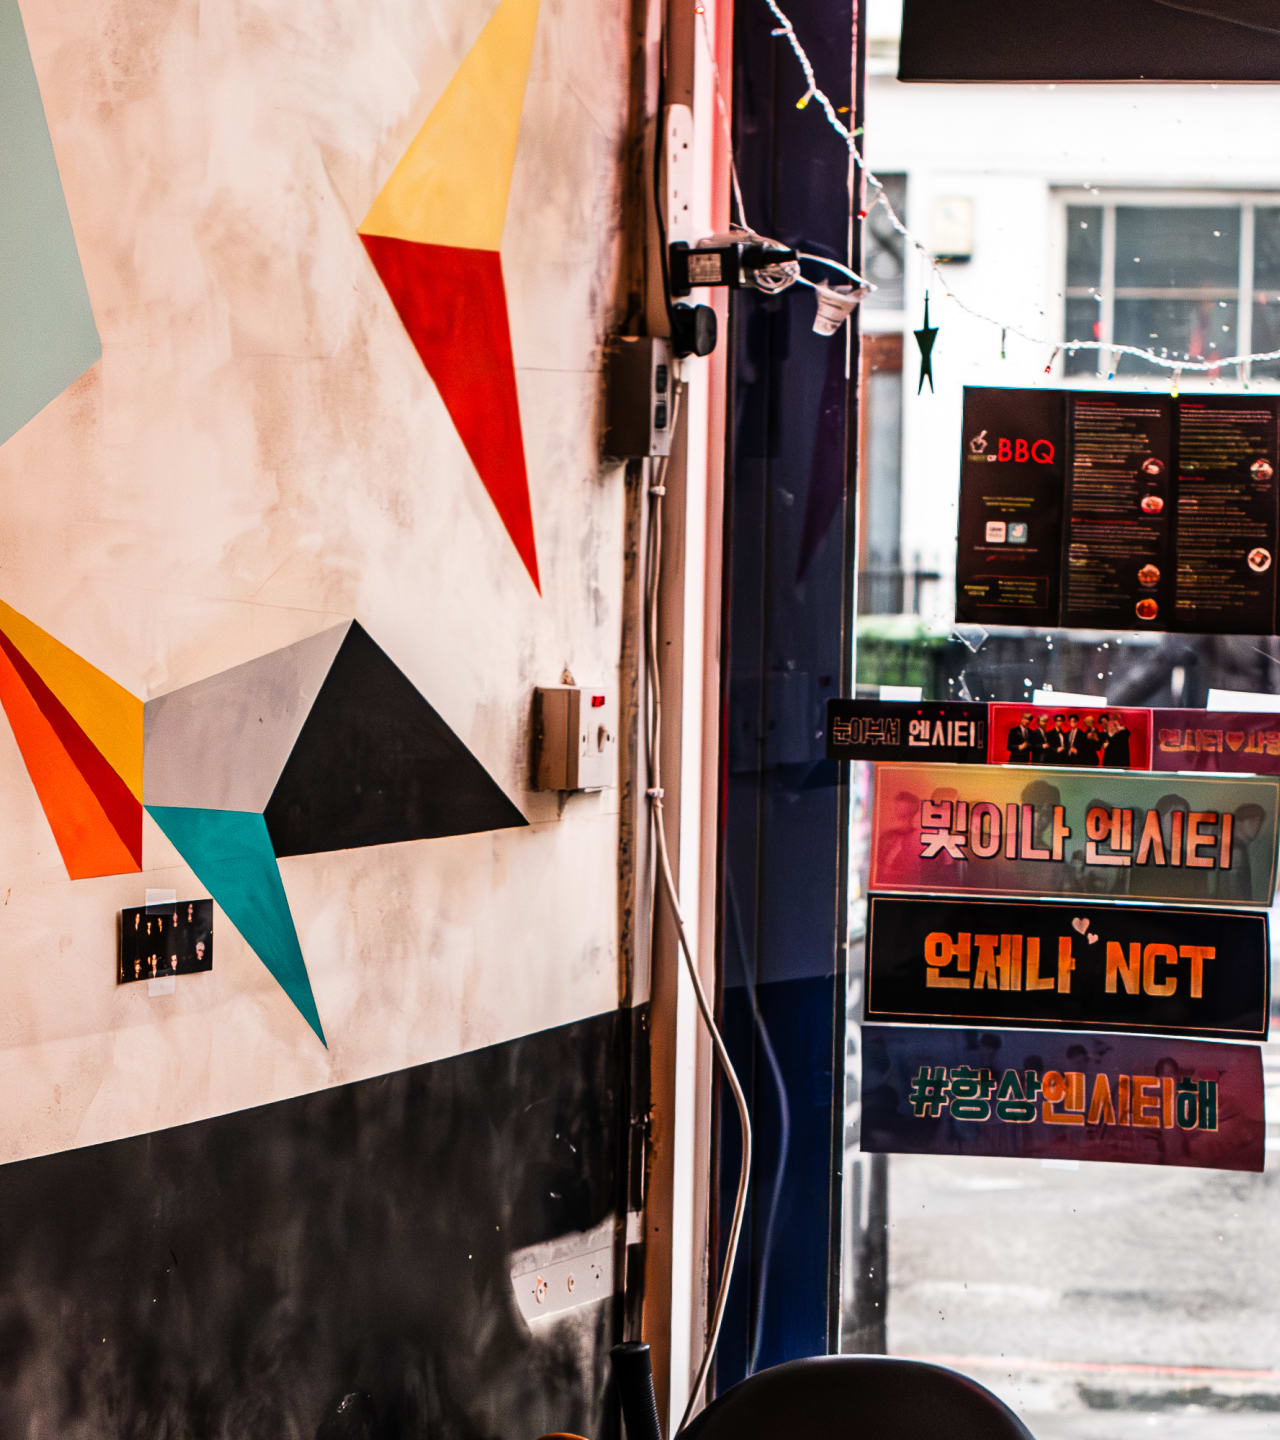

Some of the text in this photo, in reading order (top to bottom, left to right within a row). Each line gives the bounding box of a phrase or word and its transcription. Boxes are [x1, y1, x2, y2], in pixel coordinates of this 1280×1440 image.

[998, 438, 1055, 464] BBQ
[920, 800, 1235, 869] 빛이나 엔시티
[924, 932, 1216, 998] 언제나 NCT
[910, 1065, 1219, 1132] #항상엔시티해
